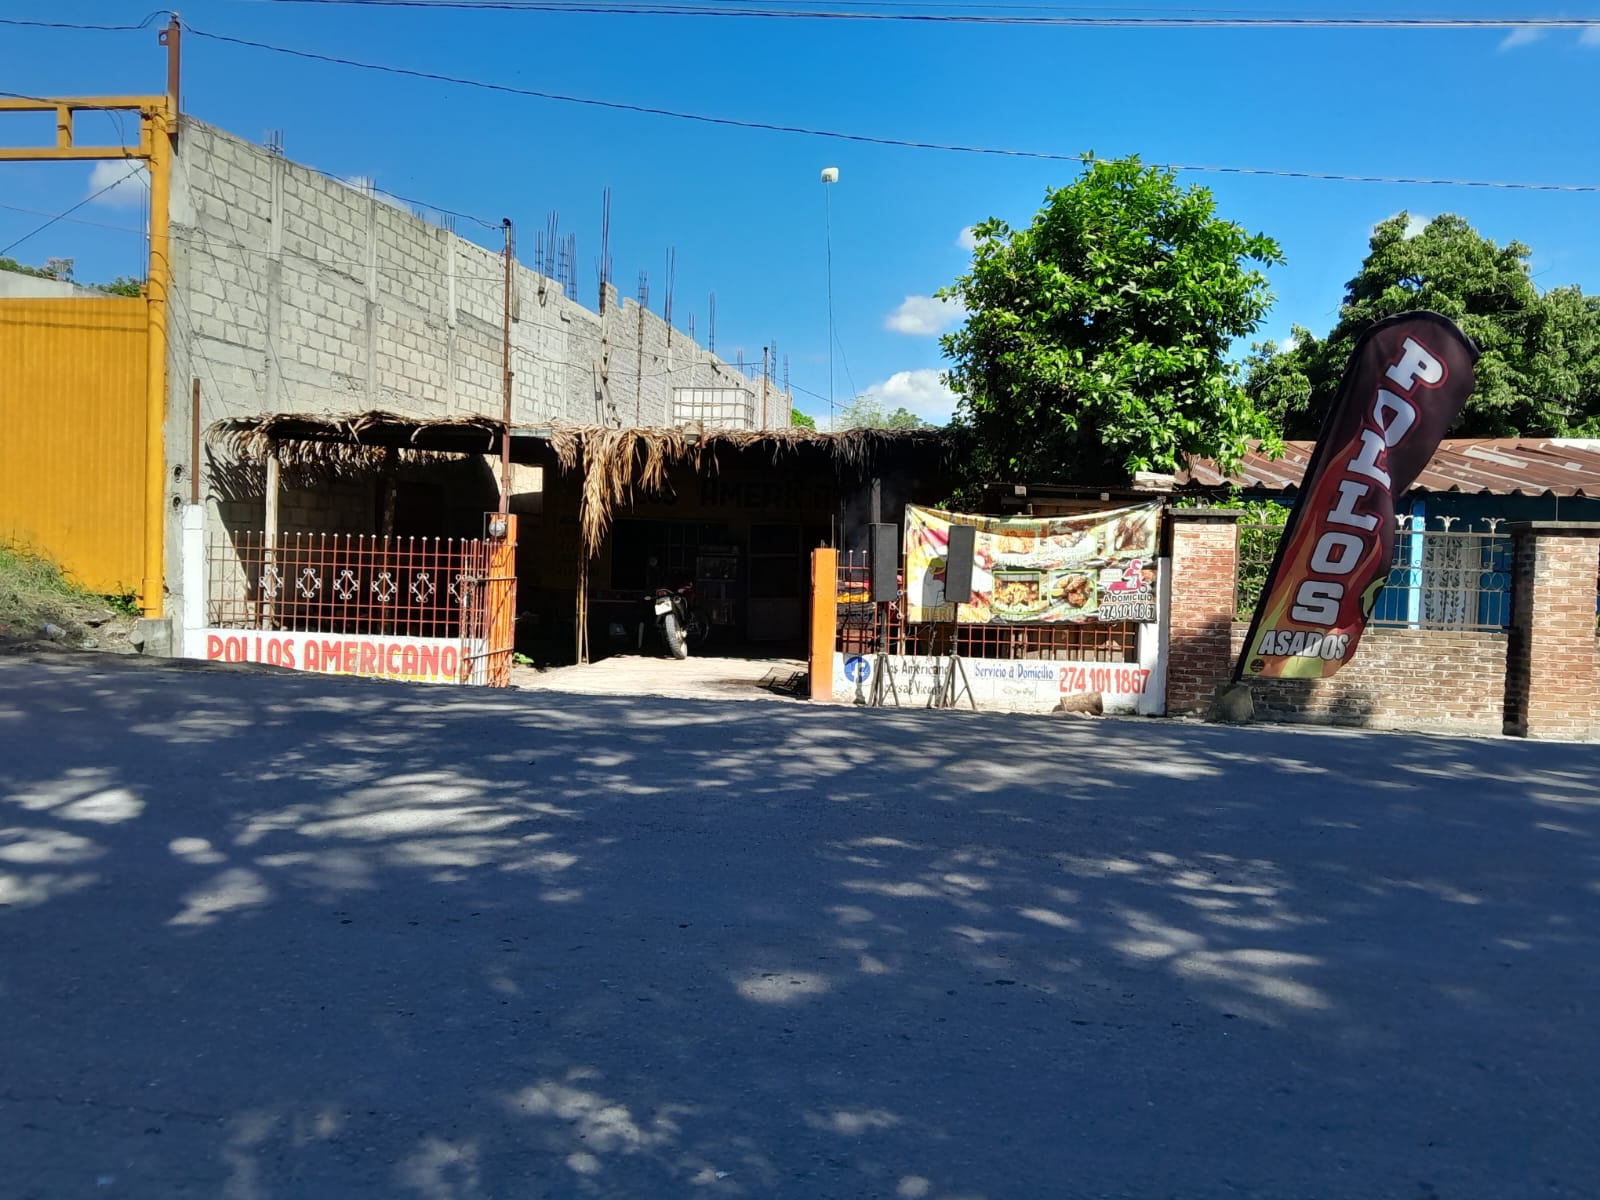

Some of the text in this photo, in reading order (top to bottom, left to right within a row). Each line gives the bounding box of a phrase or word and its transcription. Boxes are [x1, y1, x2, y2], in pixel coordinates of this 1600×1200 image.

[1289, 335, 1445, 628] POLLOS
[1100, 604, 1117, 620] 274
[1118, 602, 1133, 620] 101
[1111, 593, 1153, 603] DOMICILIO
[207, 634, 296, 669] POLLOS
[1257, 630, 1350, 660] ASADOS
[975, 662, 1007, 678] Servicio
[1017, 663, 1054, 680] Domicilio
[1059, 666, 1151, 695] 274 101 1867
